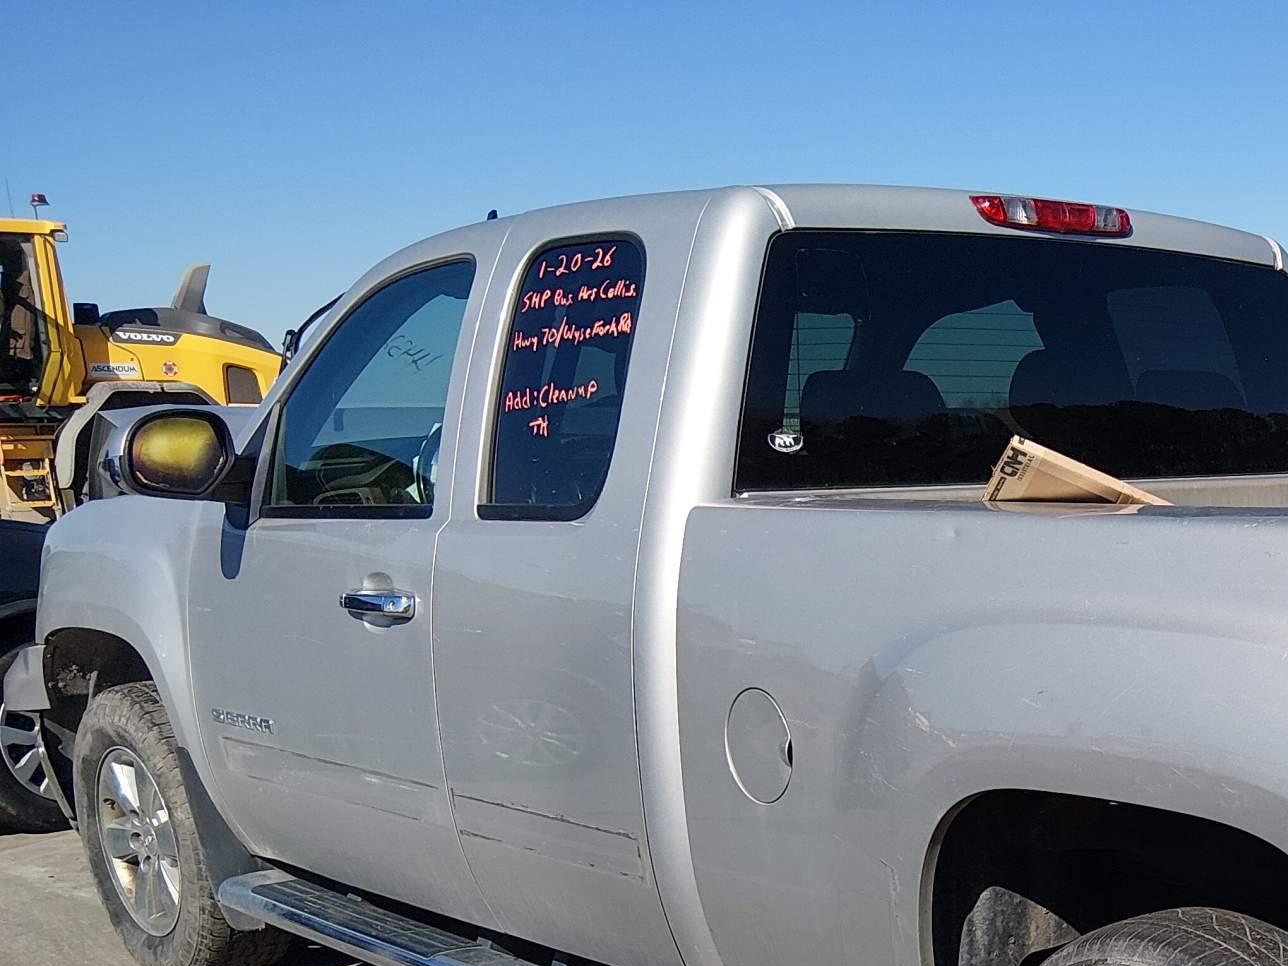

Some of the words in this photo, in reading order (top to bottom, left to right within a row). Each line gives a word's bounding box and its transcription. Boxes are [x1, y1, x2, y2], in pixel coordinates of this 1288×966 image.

[538, 246, 617, 279] 1-20-26
[521, 289, 551, 313] SHP
[115, 331, 175, 342] VOLVO
[513, 331, 538, 351] Hwy
[91, 364, 138, 373] ASCENDUM
[1000, 446, 1028, 478] CNH
[211, 708, 274, 735] SIERRA
